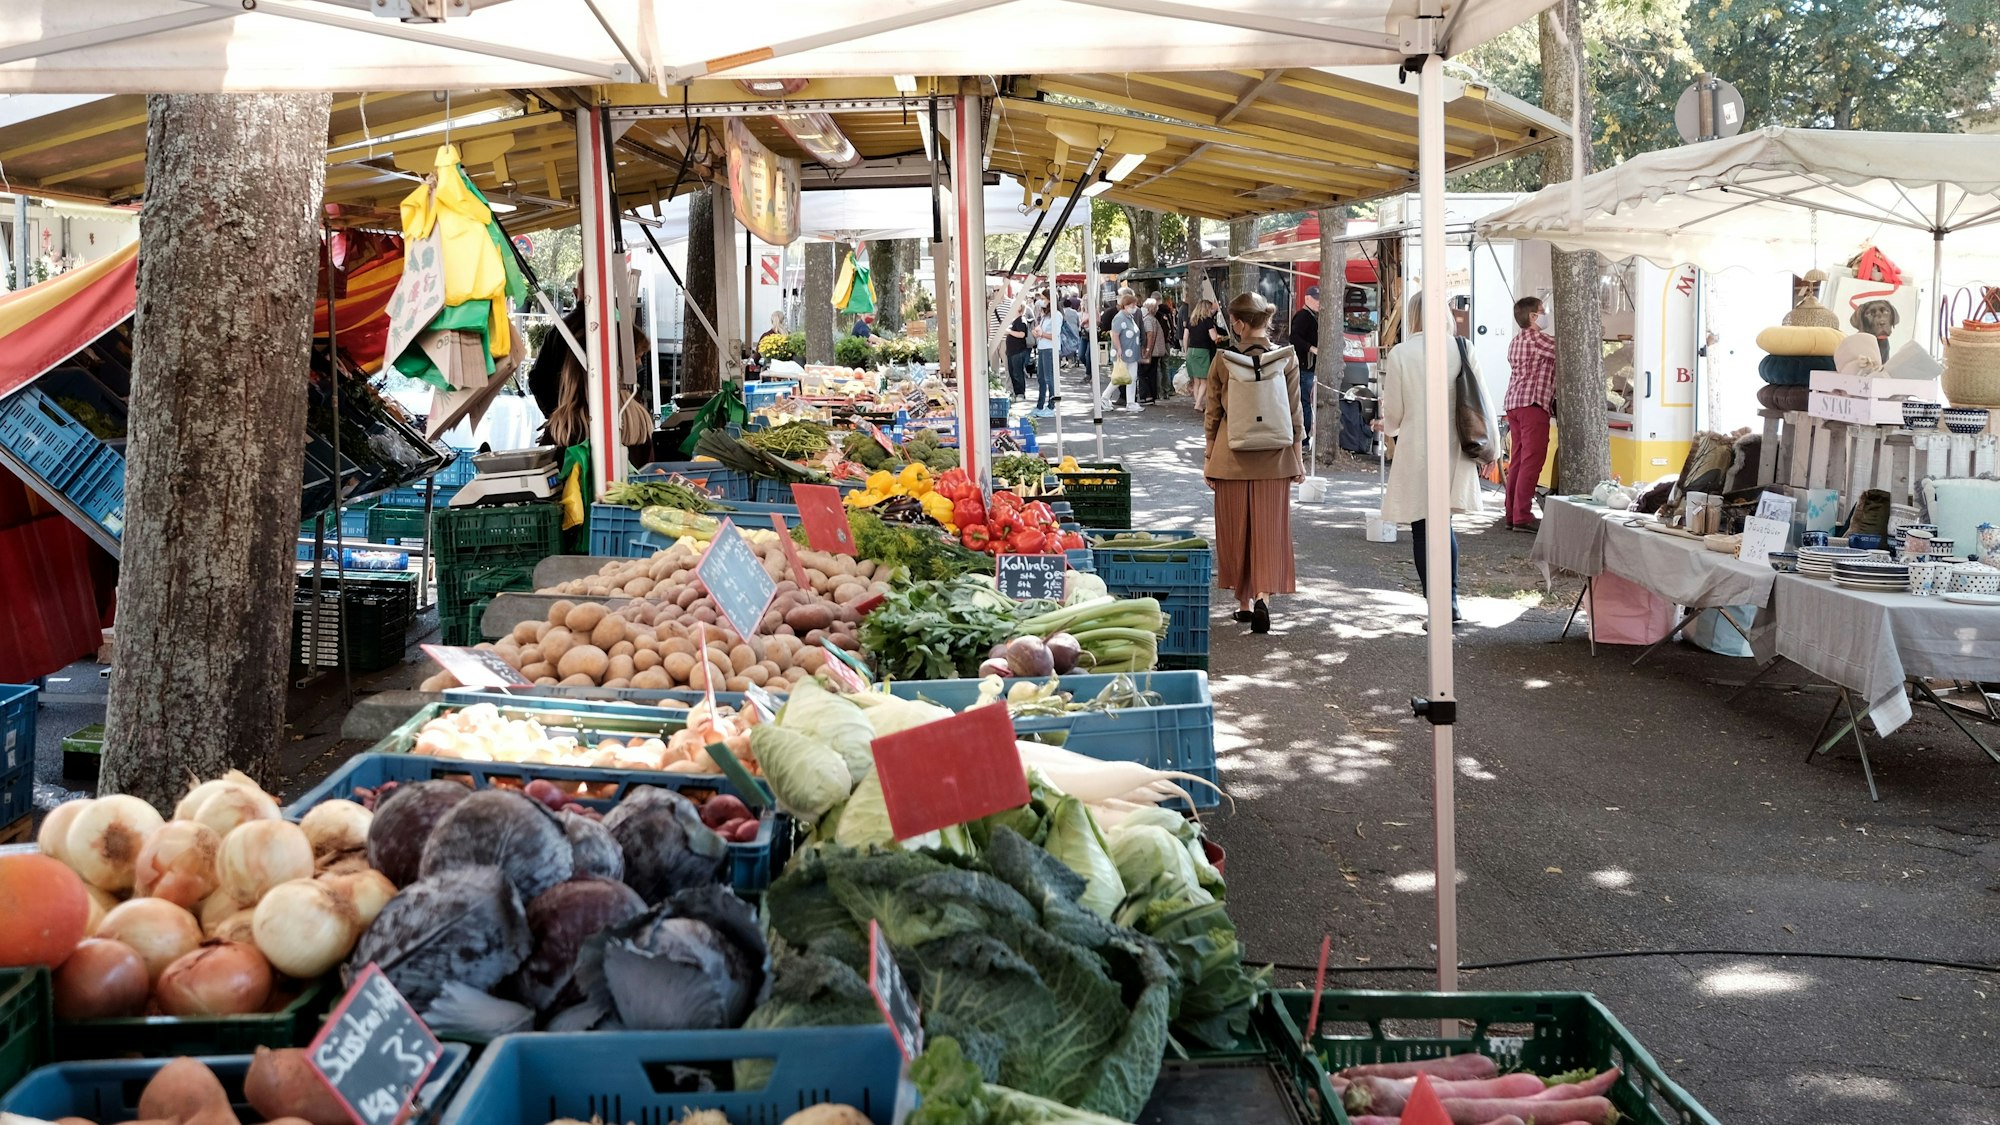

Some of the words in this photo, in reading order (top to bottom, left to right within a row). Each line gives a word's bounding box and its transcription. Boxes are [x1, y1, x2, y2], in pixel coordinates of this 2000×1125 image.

[1822, 397, 1852, 415] STAR
[1001, 556, 1055, 571] Kohlrabi
[1000, 571, 1006, 579] 1
[1000, 580, 1007, 588] 2
